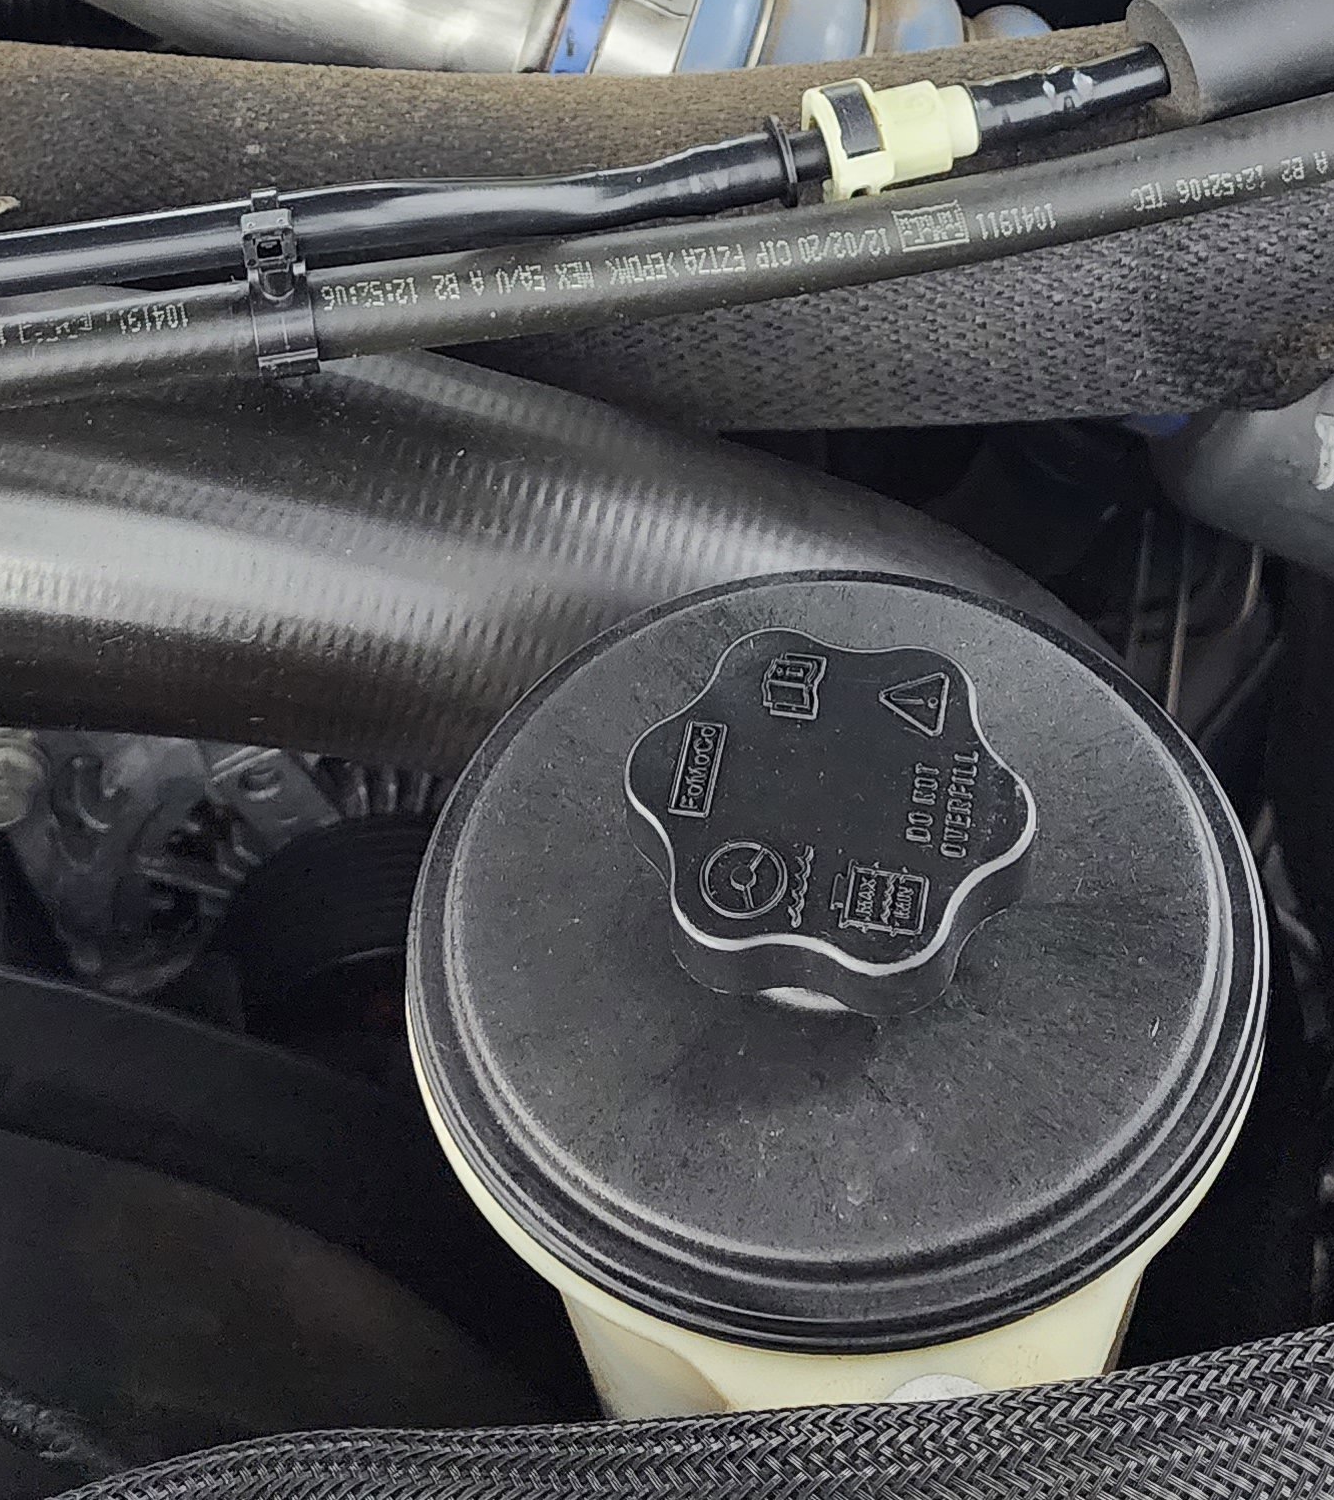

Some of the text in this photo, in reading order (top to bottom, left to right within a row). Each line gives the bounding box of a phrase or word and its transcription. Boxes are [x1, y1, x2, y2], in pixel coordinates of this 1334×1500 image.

[974, 199, 1056, 240] 1041911
[754, 235, 791, 268] CIP
[795, 222, 889, 265] 12/02/20
[554, 257, 595, 291] MEX
[105, 300, 188, 338] 104191
[679, 725, 717, 811] FoMoCo
[905, 762, 940, 847] DO NOT
[940, 750, 980, 859] OVERFILL
